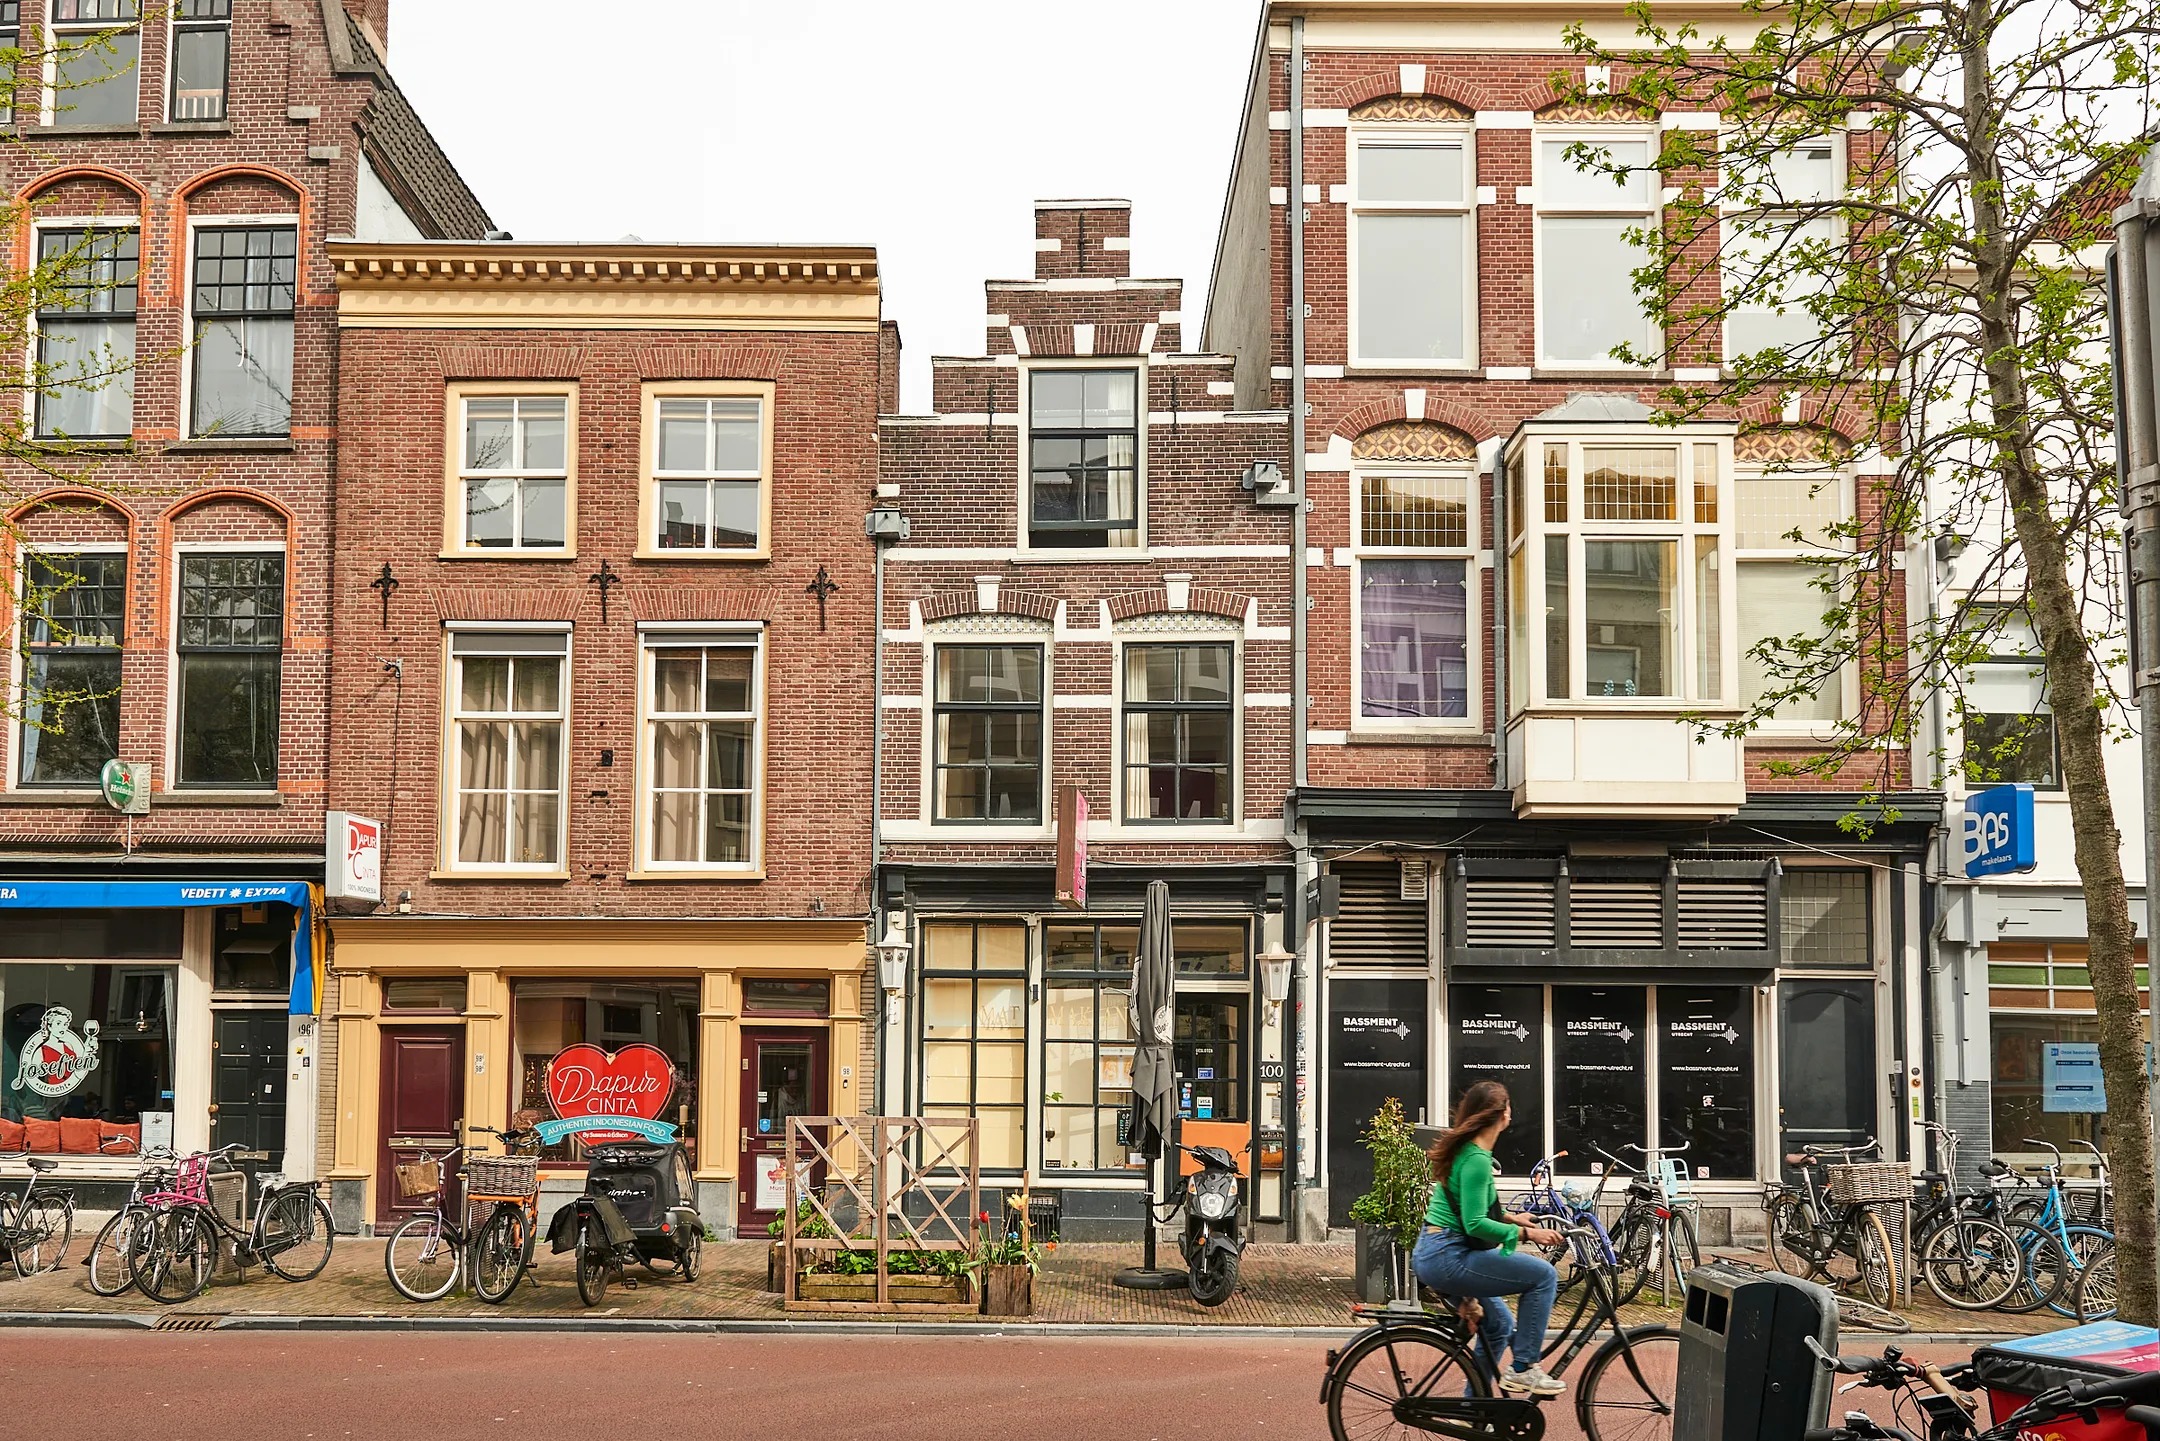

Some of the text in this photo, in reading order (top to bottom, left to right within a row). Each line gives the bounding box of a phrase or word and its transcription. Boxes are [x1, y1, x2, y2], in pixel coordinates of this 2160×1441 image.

[348, 824, 376, 854] DAPUR
[1964, 812, 2009, 864] BAS
[1982, 854, 2012, 866] makelaars
[180, 887, 286, 898] VEDETT EXTRA
[1343, 1017, 1398, 1026] BASSMENT
[1462, 1020, 1517, 1028] BASSMENT
[26, 1041, 36, 1055] bar
[14, 1054, 98, 1088] josefien
[1260, 1065, 1284, 1078] 100
[38, 1083, 68, 1092] utrecht
[556, 1066, 660, 1105] Dapur
[586, 1098, 638, 1114] CINTA
[547, 1118, 666, 1137] AUTHENTIC INDONESIAN FOOD
